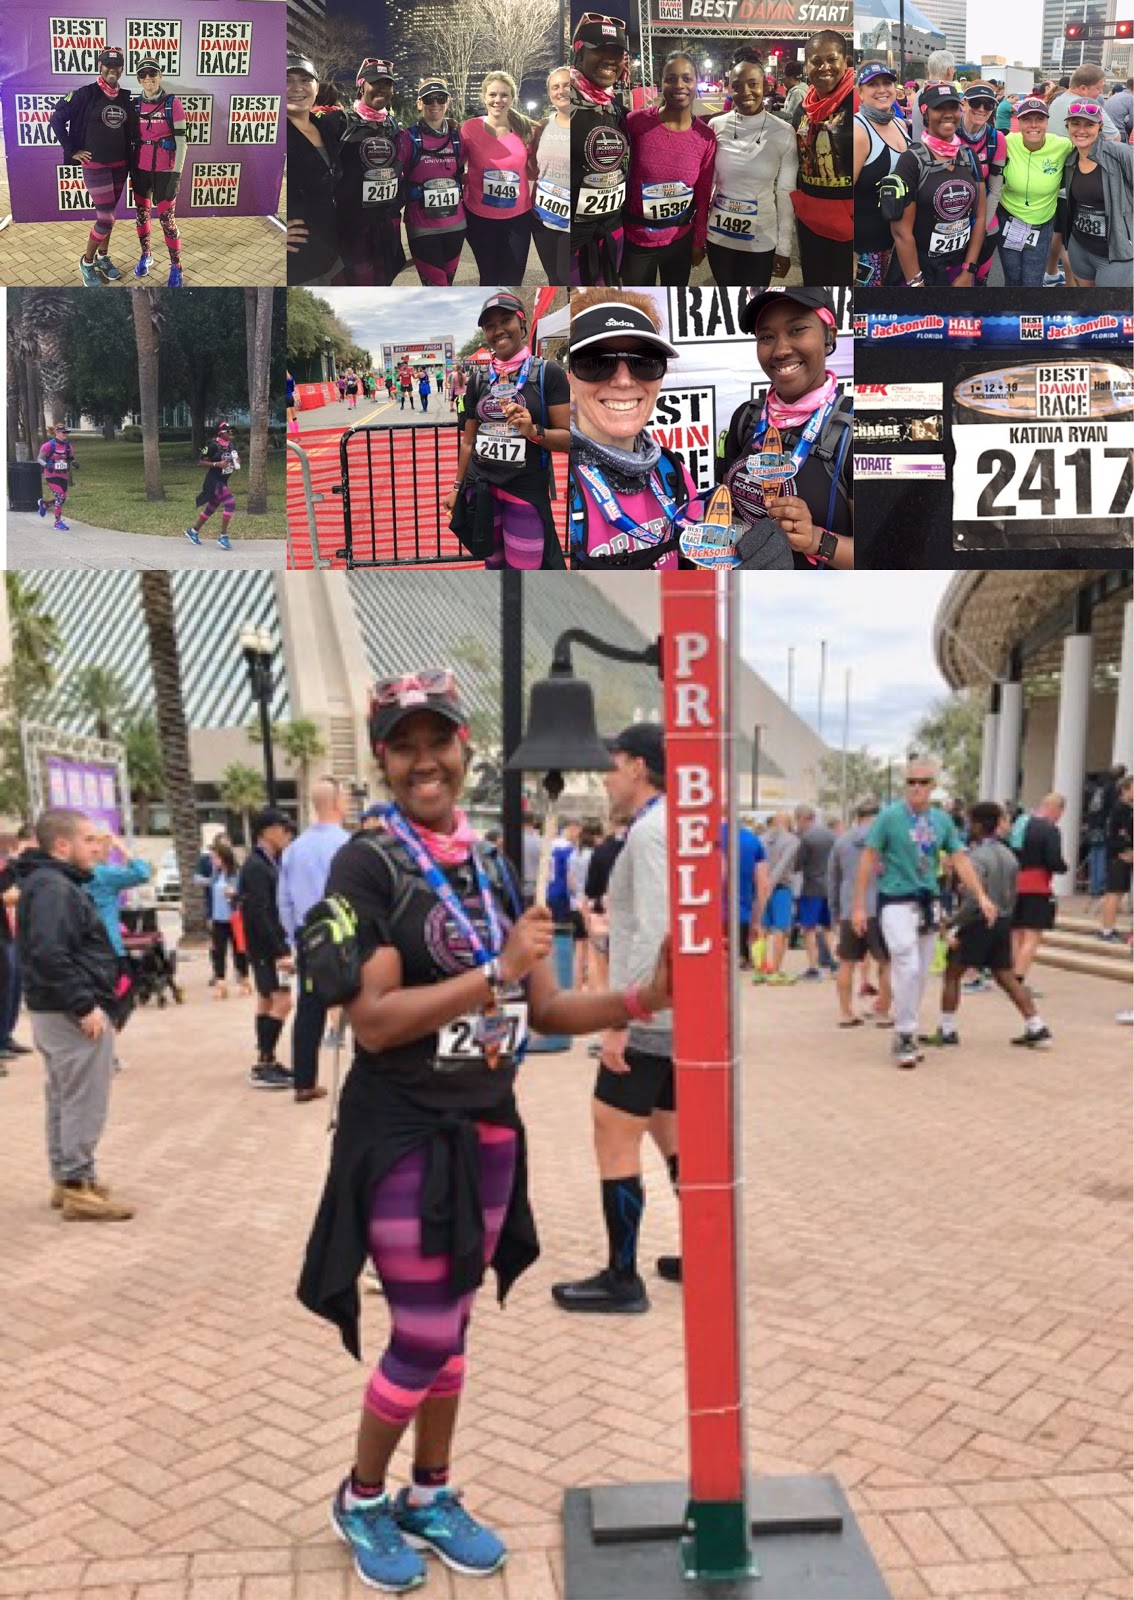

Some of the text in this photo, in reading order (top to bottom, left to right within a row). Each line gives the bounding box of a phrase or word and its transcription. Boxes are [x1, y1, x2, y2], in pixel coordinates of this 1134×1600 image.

[660, 8, 682, 19] RACE
[690, 0, 849, 22] BEST DAMN START
[52, 20, 104, 35] BEST
[129, 22, 178, 37] BEST
[201, 23, 250, 38] BEST
[53, 36, 105, 48] DAMN
[129, 38, 178, 50] DAMN
[201, 39, 249, 51] DAMN
[200, 51, 248, 74] RACE
[232, 97, 279, 110] BEST
[231, 112, 277, 122] DAMN
[230, 123, 276, 142] RACE
[195, 165, 239, 176] BEST
[194, 178, 238, 187] DAMN
[193, 187, 236, 205] RACE
[368, 183, 397, 201] 2417
[488, 183, 517, 199] 1449
[428, 192, 456, 207] 2141
[539, 195, 570, 217] 1400
[584, 189, 624, 214] 2417
[715, 214, 752, 234] 1492
[935, 232, 969, 252] 2417
[605, 317, 635, 328] adidas
[872, 316, 981, 338] Jacksonville HALF
[1047, 315, 1117, 339] Jacksonville
[1021, 329, 1042, 339] RACE
[1039, 368, 1088, 382] BEST
[1039, 383, 1088, 394] DAMN
[1040, 395, 1087, 416] RACE
[1010, 426, 1108, 443] KATINA RYAN
[480, 441, 521, 461] 2417
[751, 464, 797, 475] Jacksonville
[853, 457, 892, 471] YDRATE
[977, 448, 1133, 517] 2417
[685, 536, 701, 545] RACE
[711, 562, 733, 571] 2019
[675, 766, 714, 954] BELL
